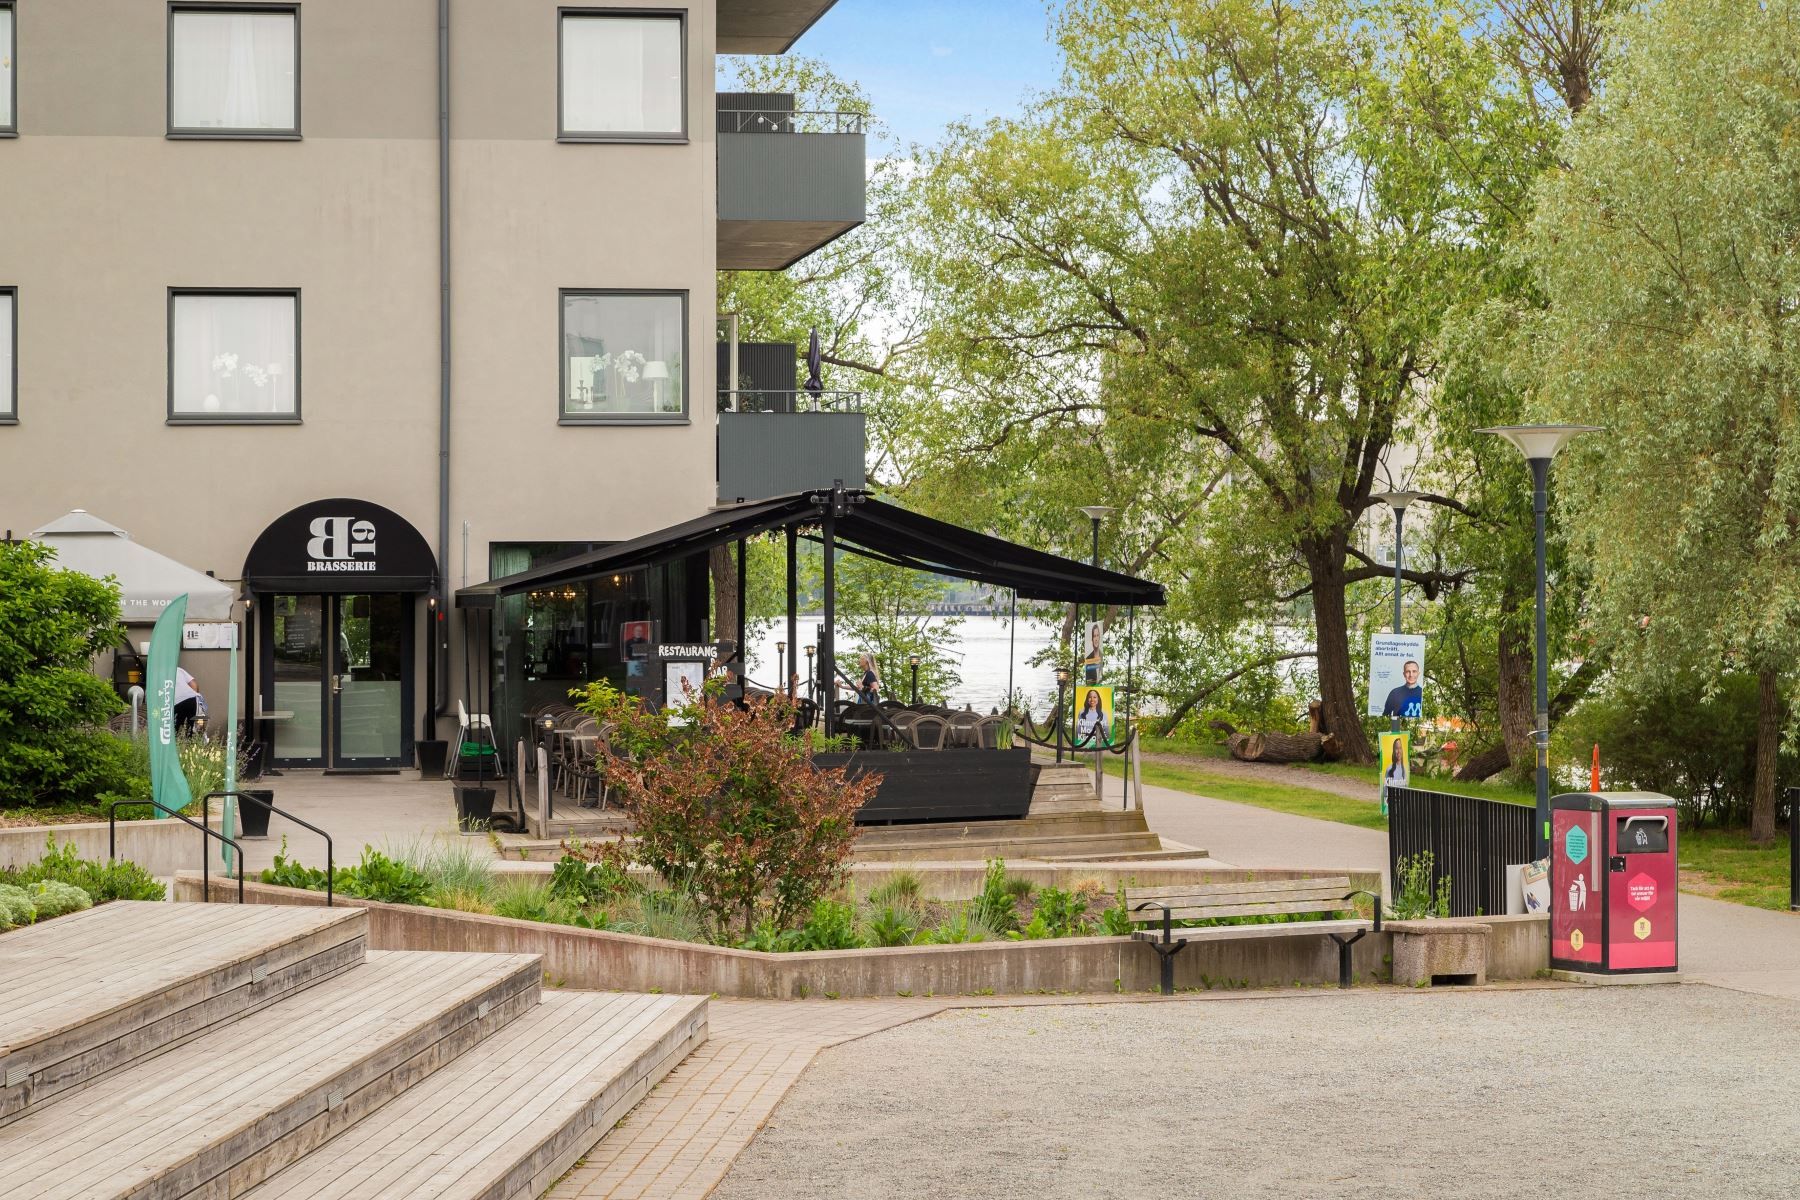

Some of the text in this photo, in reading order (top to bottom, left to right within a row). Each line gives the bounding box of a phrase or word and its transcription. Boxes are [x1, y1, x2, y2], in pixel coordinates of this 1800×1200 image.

[307, 561, 376, 572] BRASSERIE
[658, 645, 718, 658] RESTAURANG
[160, 679, 174, 745] Carlsberg
